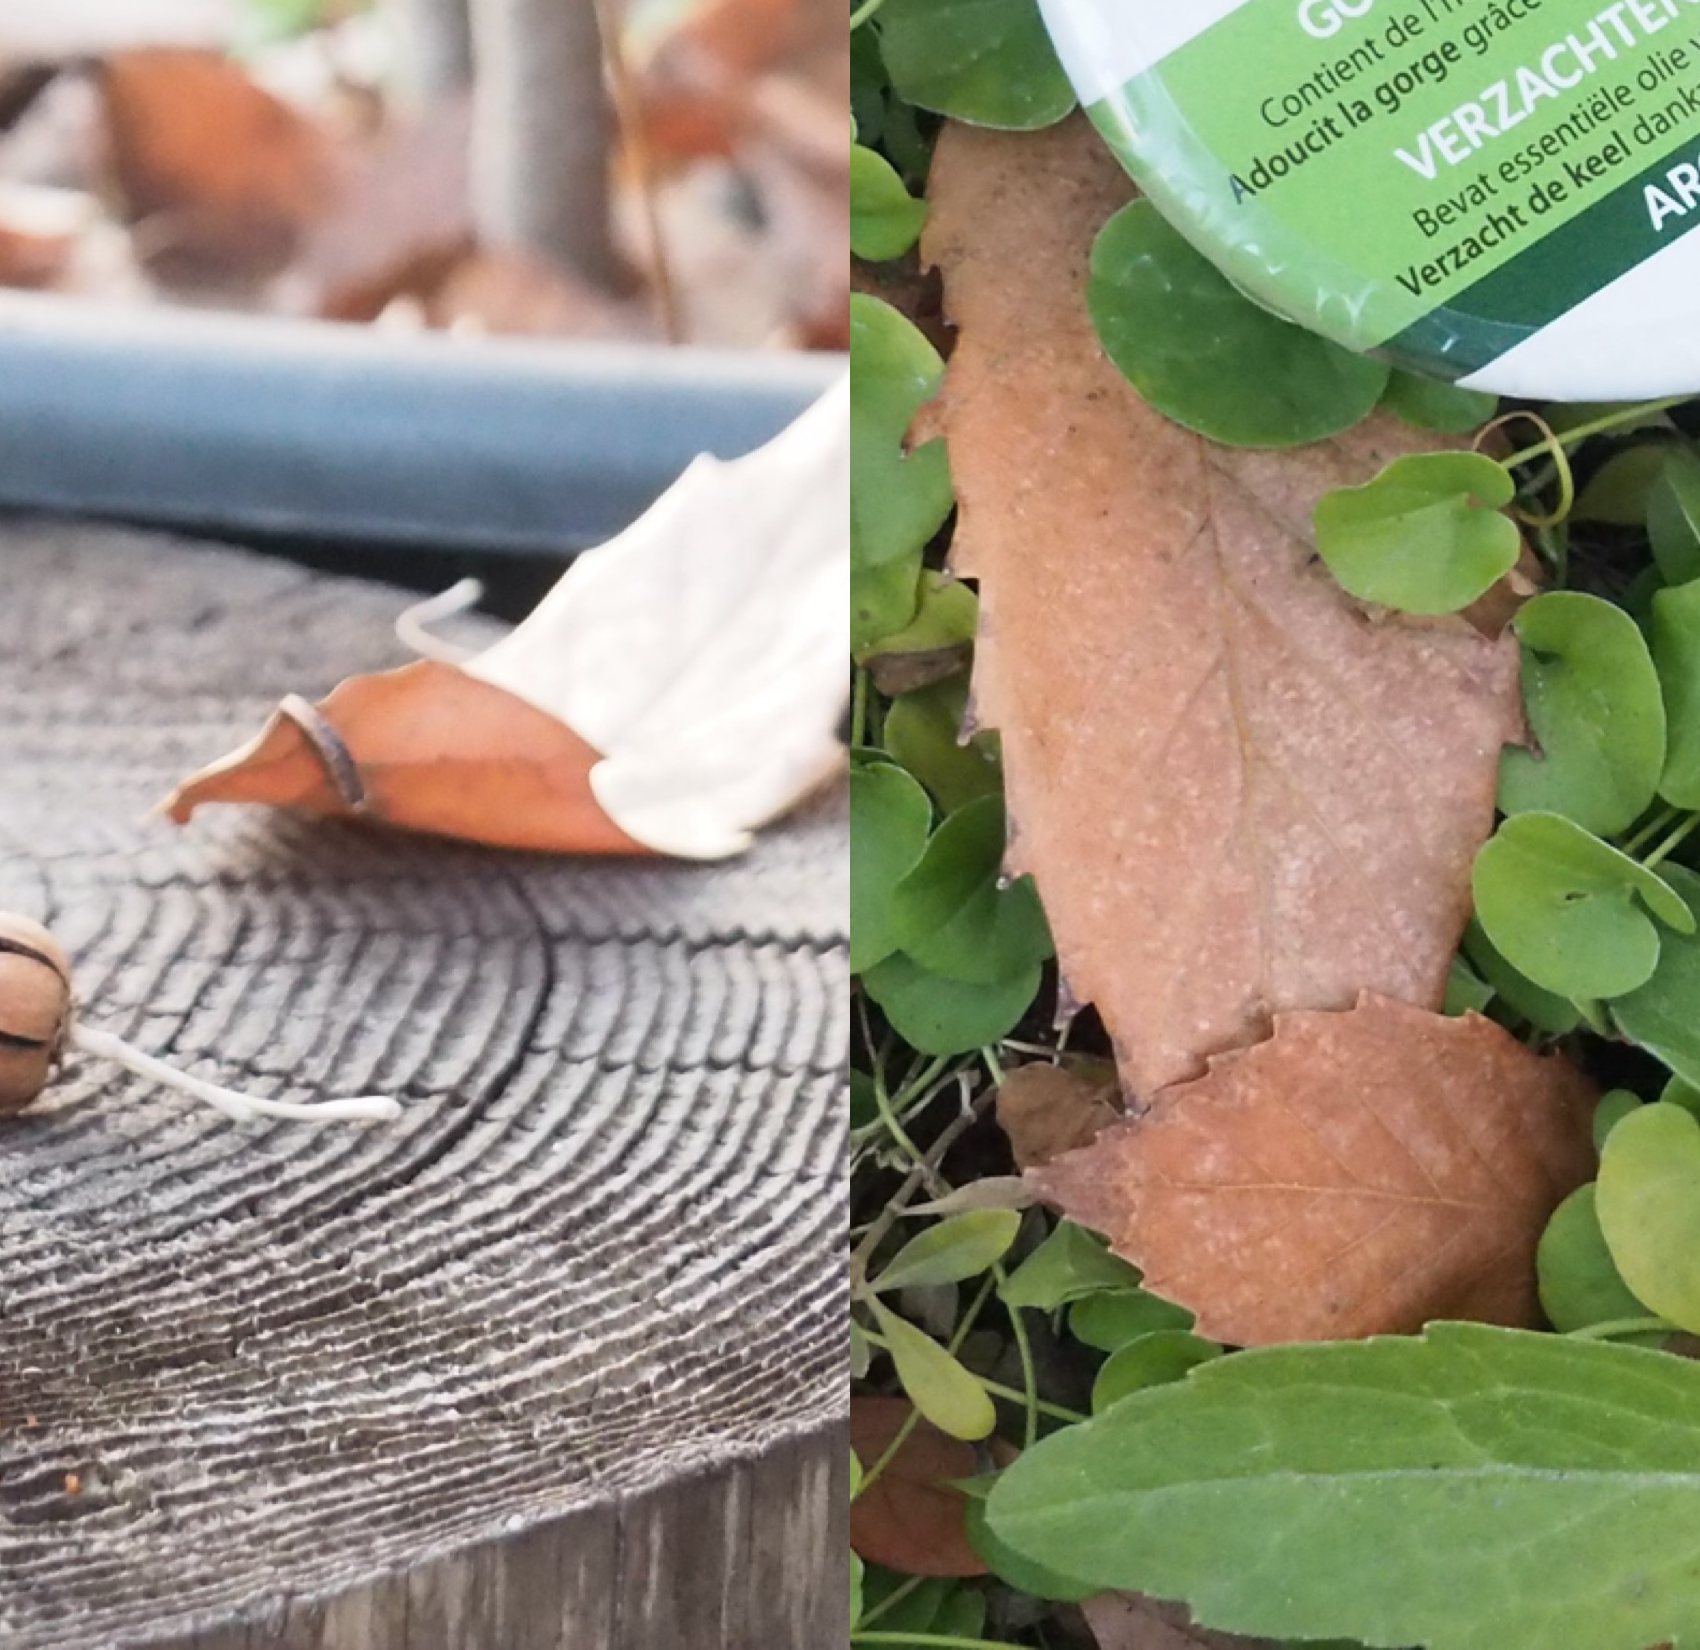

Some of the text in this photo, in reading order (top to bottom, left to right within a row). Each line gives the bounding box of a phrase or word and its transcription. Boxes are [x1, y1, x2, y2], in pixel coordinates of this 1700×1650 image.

[1229, 117, 1344, 204] Adoucit
[1344, 99, 1373, 130] la
[1374, 42, 1461, 114] gorge
[1261, 38, 1386, 129] Contient
[1385, 14, 1425, 49] de
[1413, 173, 1499, 237] Bevat
[1499, 79, 1635, 184] essentiële
[1636, 42, 1690, 93] olie
[1396, 210, 1528, 297] Verzacht
[1528, 181, 1568, 216] de
[1573, 131, 1634, 188] keel
